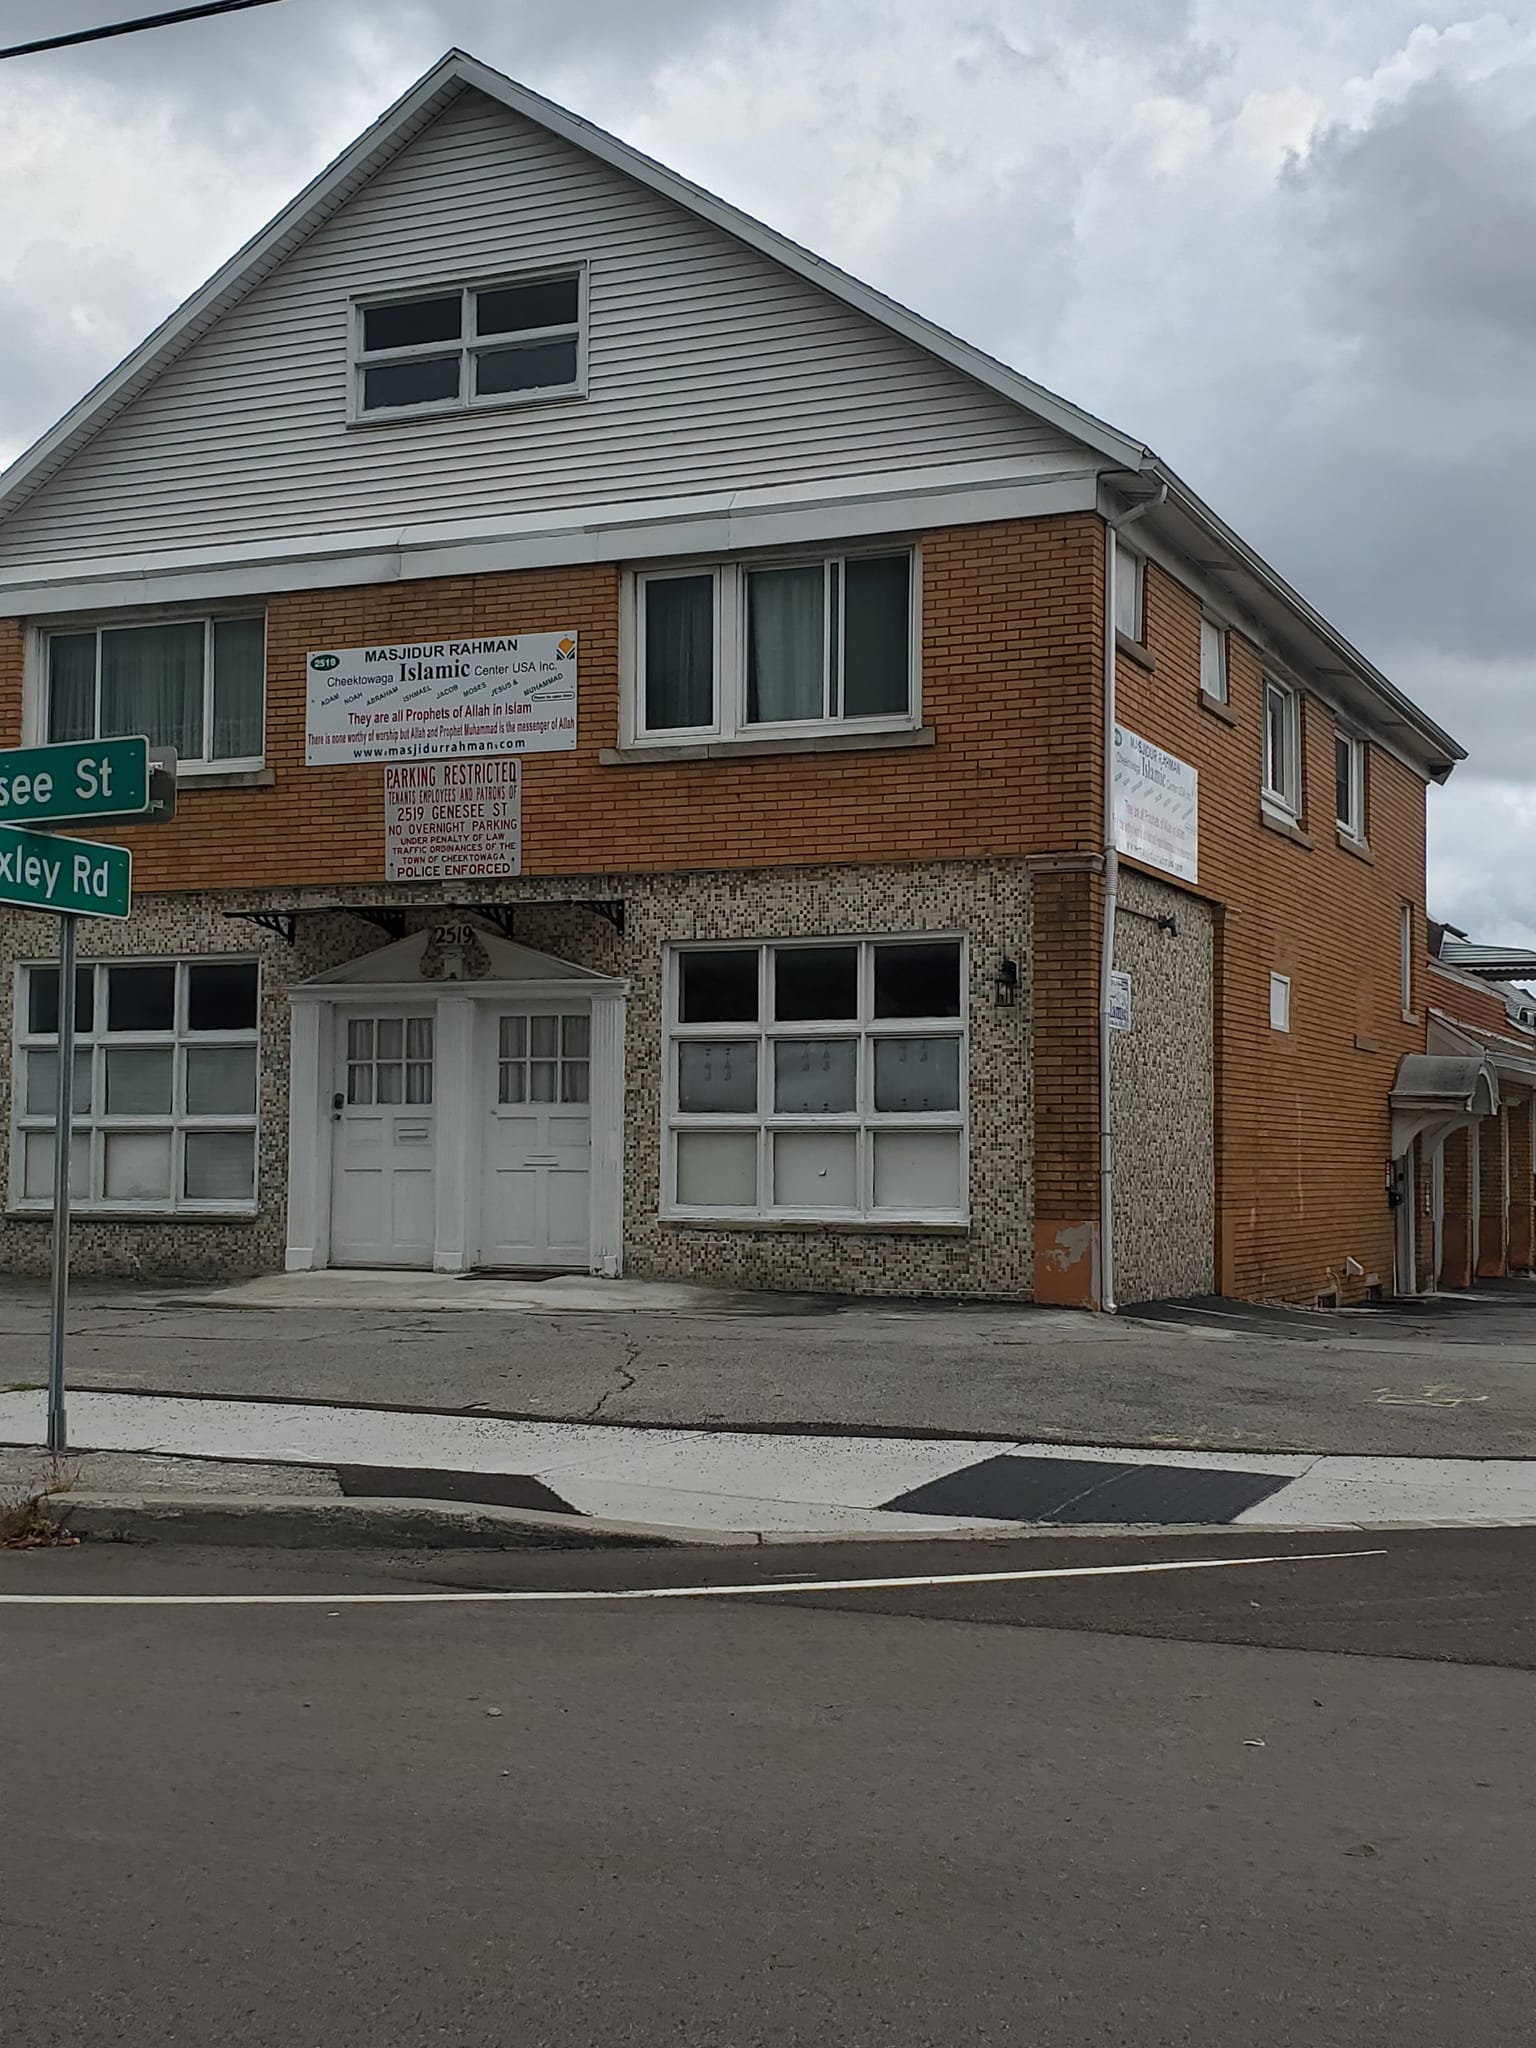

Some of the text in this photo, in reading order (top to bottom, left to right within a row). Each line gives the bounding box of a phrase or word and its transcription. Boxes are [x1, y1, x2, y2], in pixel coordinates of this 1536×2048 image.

[365, 639, 518, 662] MASJIDUR RAHMAN
[327, 659, 558, 687] Cheektowaga Islamic Center USA Inc.
[320, 692, 340, 707] ADAM
[343, 692, 363, 704] NOAH
[366, 686, 399, 706] ABRAHAM
[402, 685, 432, 703] ISHMAEL
[436, 684, 459, 700] JACOB
[463, 681, 487, 697] MOSES
[490, 681, 512, 696] JESUS
[523, 672, 564, 696] MUHAMMAD
[348, 701, 532, 728] They are all Prophets of Allah in Islam
[308, 733, 324, 745] There
[347, 731, 367, 746] worthy
[439, 724, 463, 740] Prophet
[517, 721, 550, 734] messenger
[353, 739, 526, 758] www.masjidurrahman.com
[76, 757, 113, 799] St
[387, 762, 517, 789] PARKING RESTRICTED
[388, 785, 518, 805] TENANTS EMPLOYEES AND PATRONS OF
[398, 803, 508, 821] 2519 GENESEE ST
[389, 819, 517, 836] NO OVERNIGHT PARKING
[393, 842, 516, 855] TRAFFIC ORDINANCES OF THE
[401, 836, 428, 845] UNDER
[431, 834, 469, 844] PENALTY
[472, 834, 483, 842] OF
[403, 853, 506, 865] TOWN OF CHEEKTOWAGA
[73, 854, 109, 898] Rd
[397, 863, 511, 878] POLICE ENFORCED
[434, 925, 472, 944] 2519
